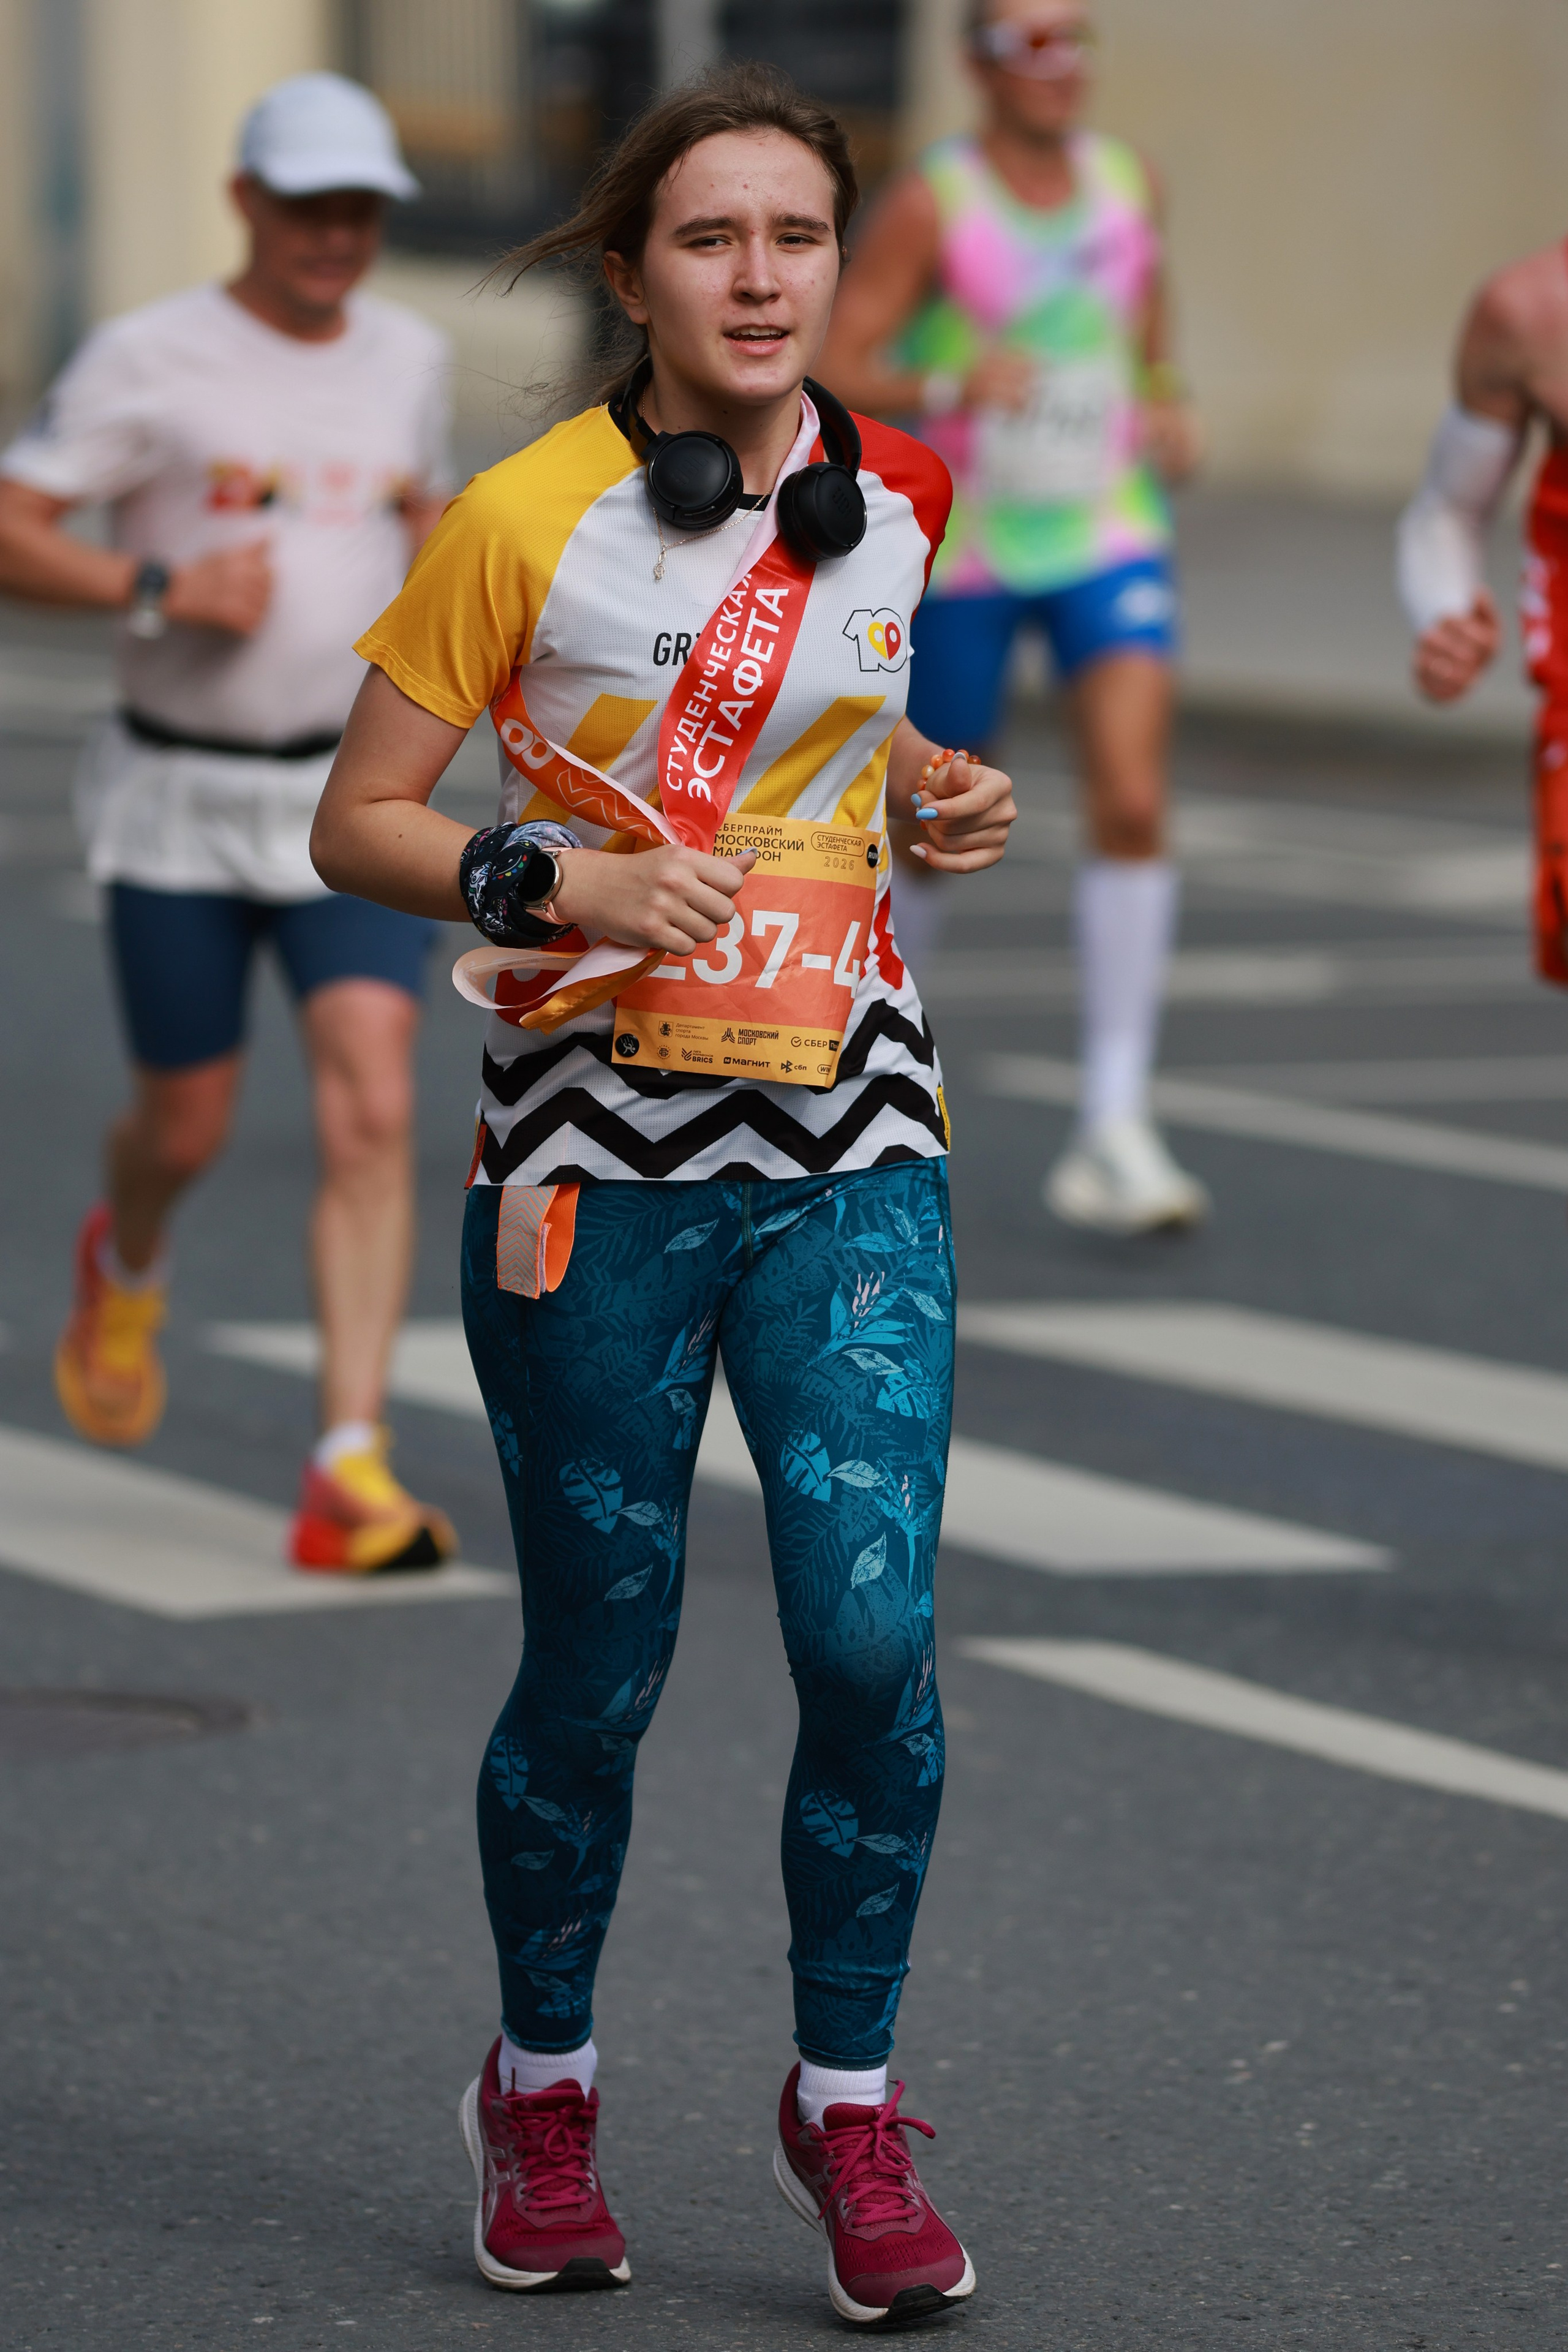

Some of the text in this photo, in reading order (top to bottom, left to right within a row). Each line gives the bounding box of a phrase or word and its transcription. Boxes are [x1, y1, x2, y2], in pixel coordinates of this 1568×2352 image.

[652, 631, 701, 666] GR
[687, 588, 790, 804] ЭСТАФЕТА
[714, 833, 805, 851] МОСКОВСКИЙ
[816, 834, 862, 847] СТУДЕНЧЕСКАЯ
[816, 842, 848, 852] ЭСТАФЕТА
[712, 846, 782, 862] МАРОН
[823, 856, 855, 871] 2026
[647, 909, 861, 999] 37-4
[737, 1036, 758, 1046] СПОРТ
[738, 1028, 779, 1040] МОСКОВСКИЙ
[804, 1039, 828, 1048] СБЕР
